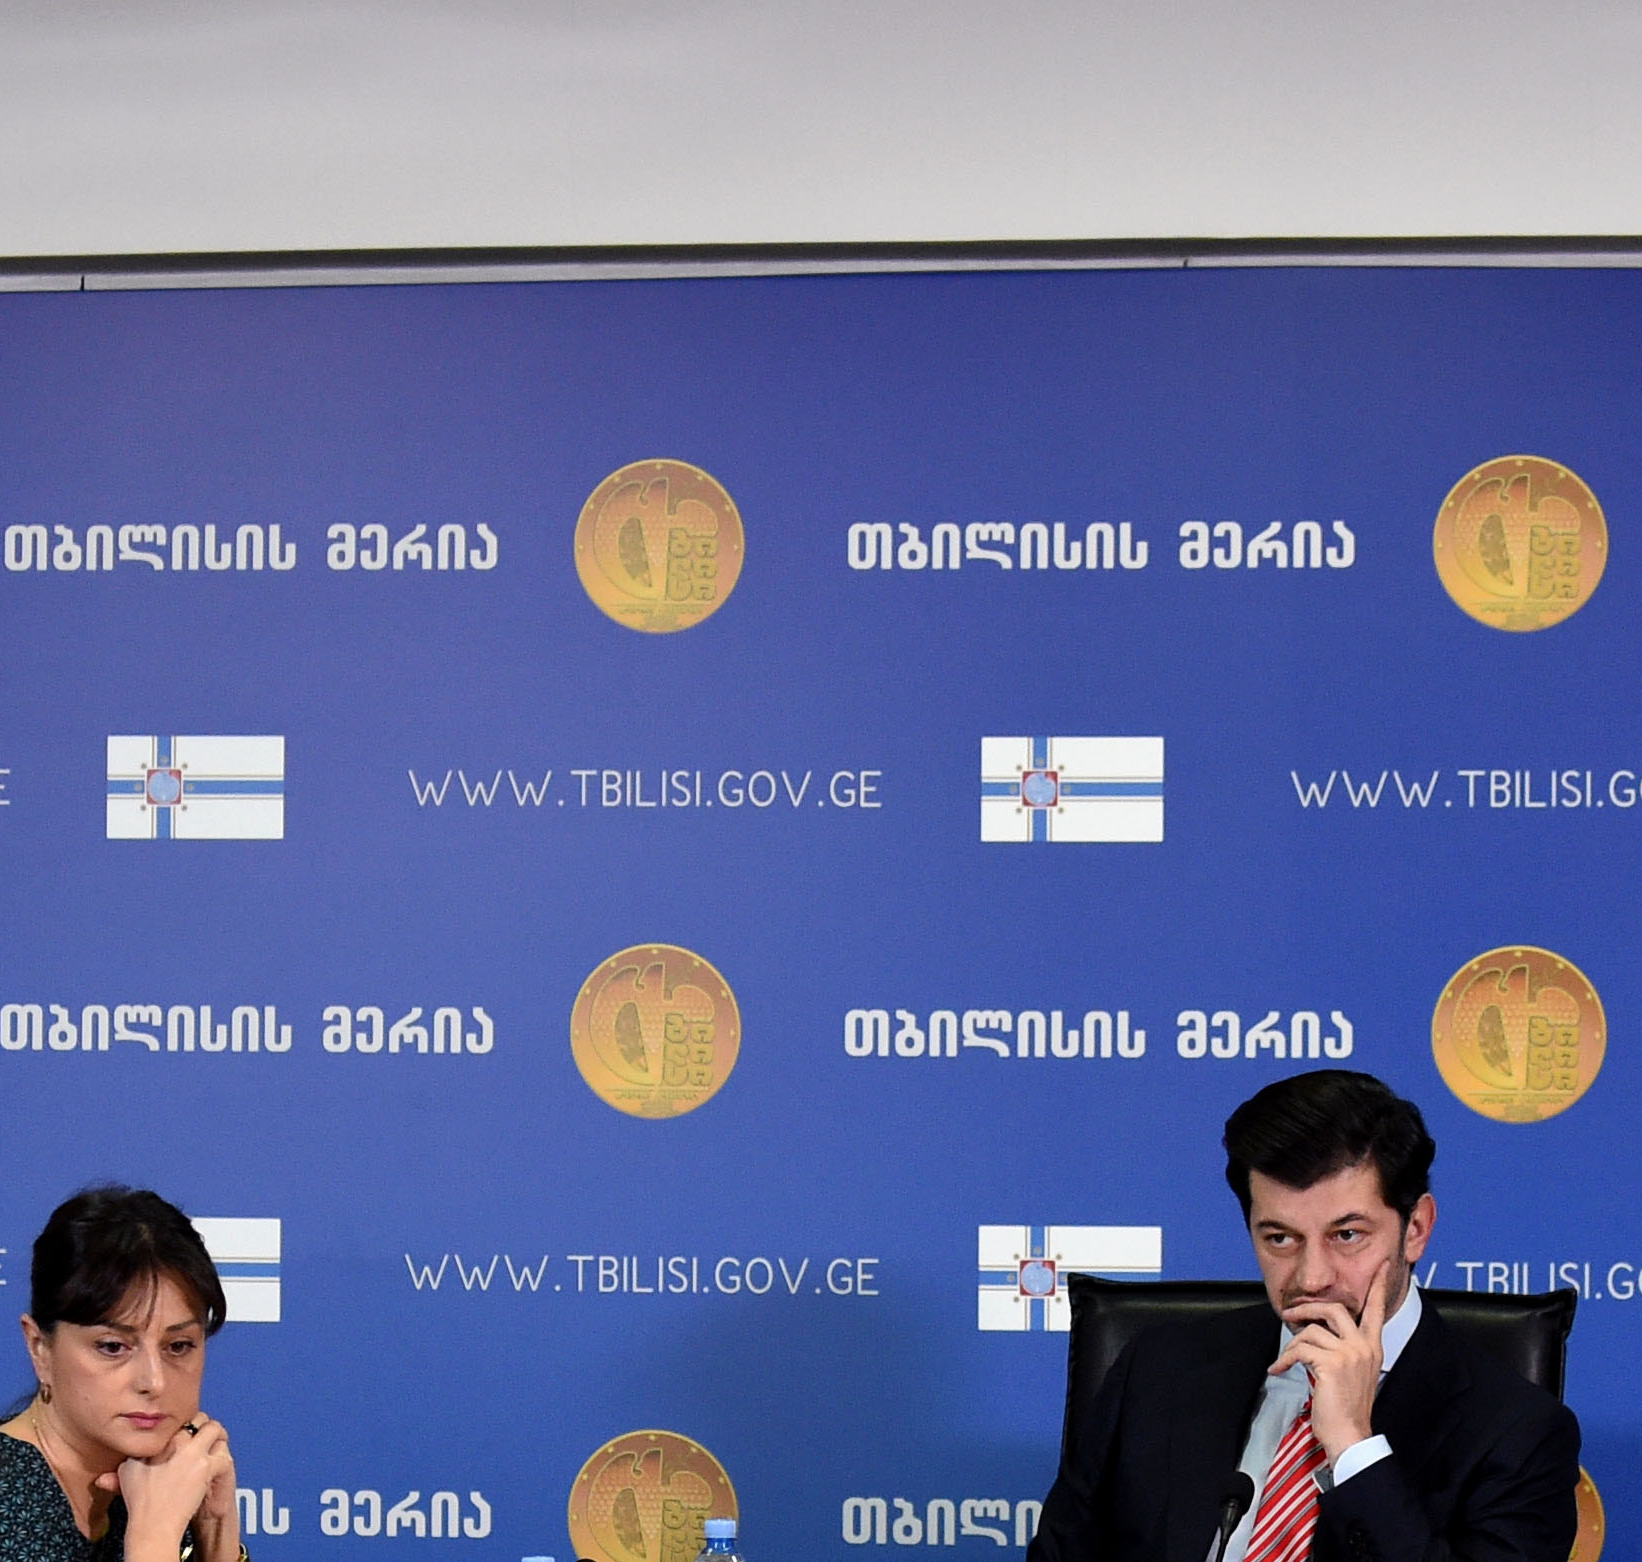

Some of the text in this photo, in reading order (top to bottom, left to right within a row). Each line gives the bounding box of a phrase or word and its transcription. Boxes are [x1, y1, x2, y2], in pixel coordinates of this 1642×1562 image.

[4, 522, 499, 572] თბილისის მერია
[847, 520, 1356, 570] თბილისის მერია
[407, 769, 882, 808] WWW.TBILISI.GOV.GE
[0, 1003, 494, 1054] თბილისის მერია
[844, 1008, 1354, 1059] თბილისის მერია
[404, 1253, 880, 1295] WWW.TBILISI.GOV.GE
[320, 1488, 492, 1538] მერია
[842, 1496, 1043, 1547] თბილი
